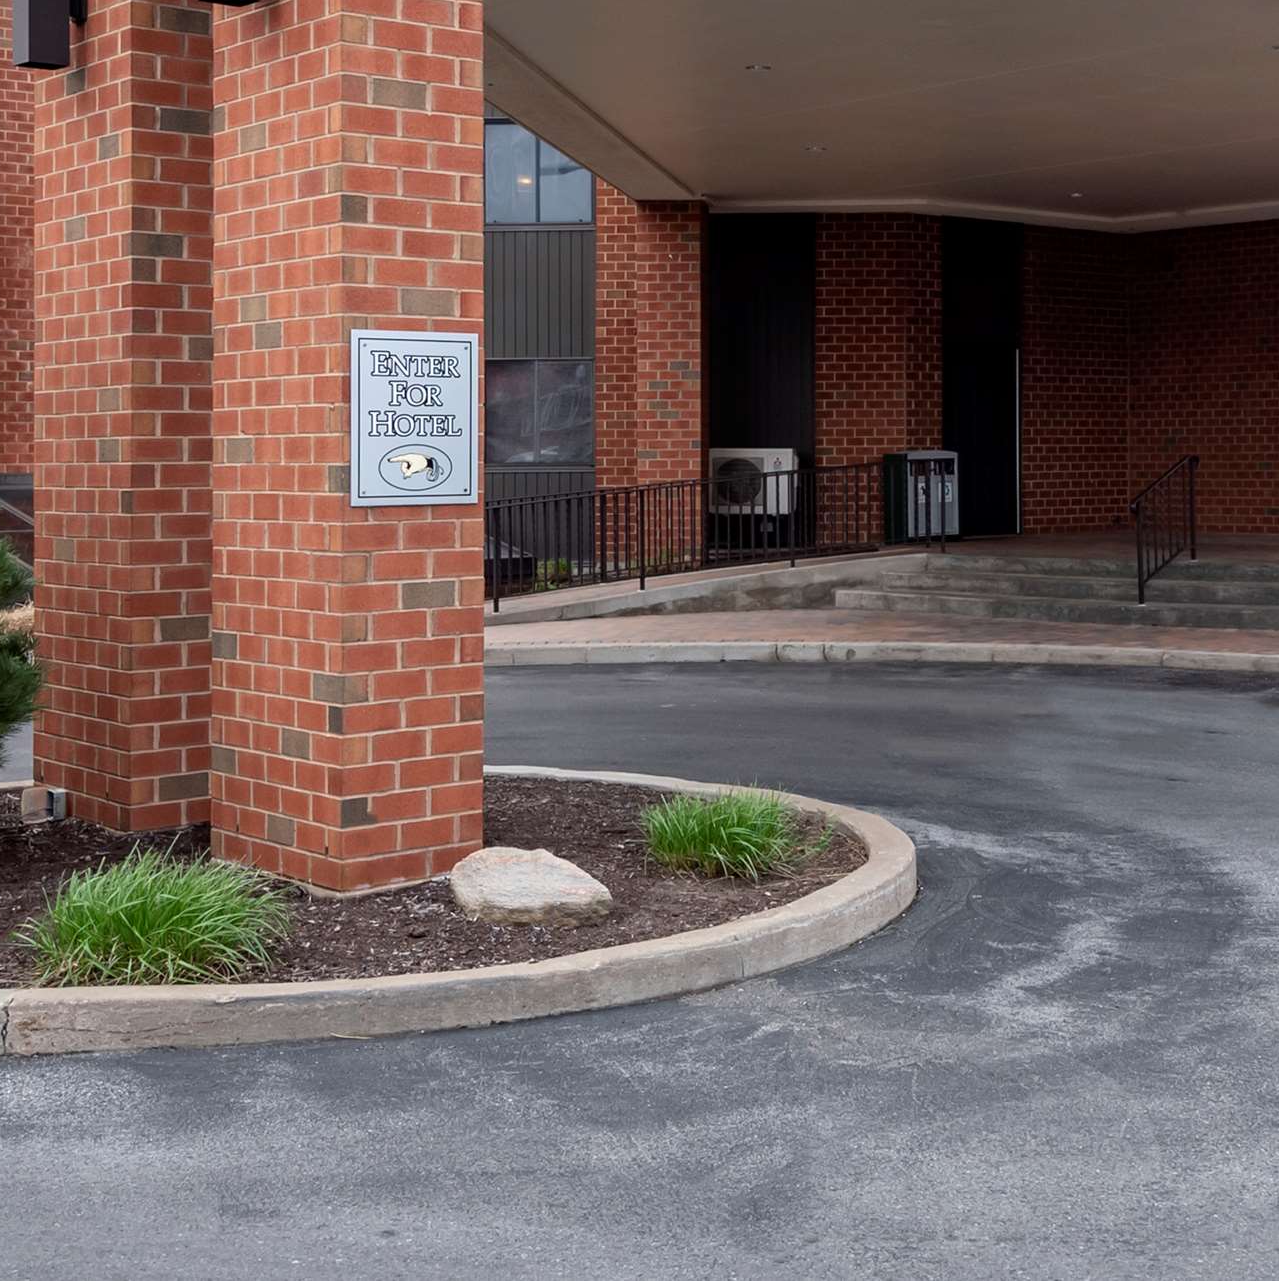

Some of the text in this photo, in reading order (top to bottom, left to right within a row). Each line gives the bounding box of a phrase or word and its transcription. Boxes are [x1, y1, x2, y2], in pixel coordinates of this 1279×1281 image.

[370, 350, 460, 378] ENTER
[389, 380, 443, 407] FOR
[368, 410, 463, 437] HOTEL
